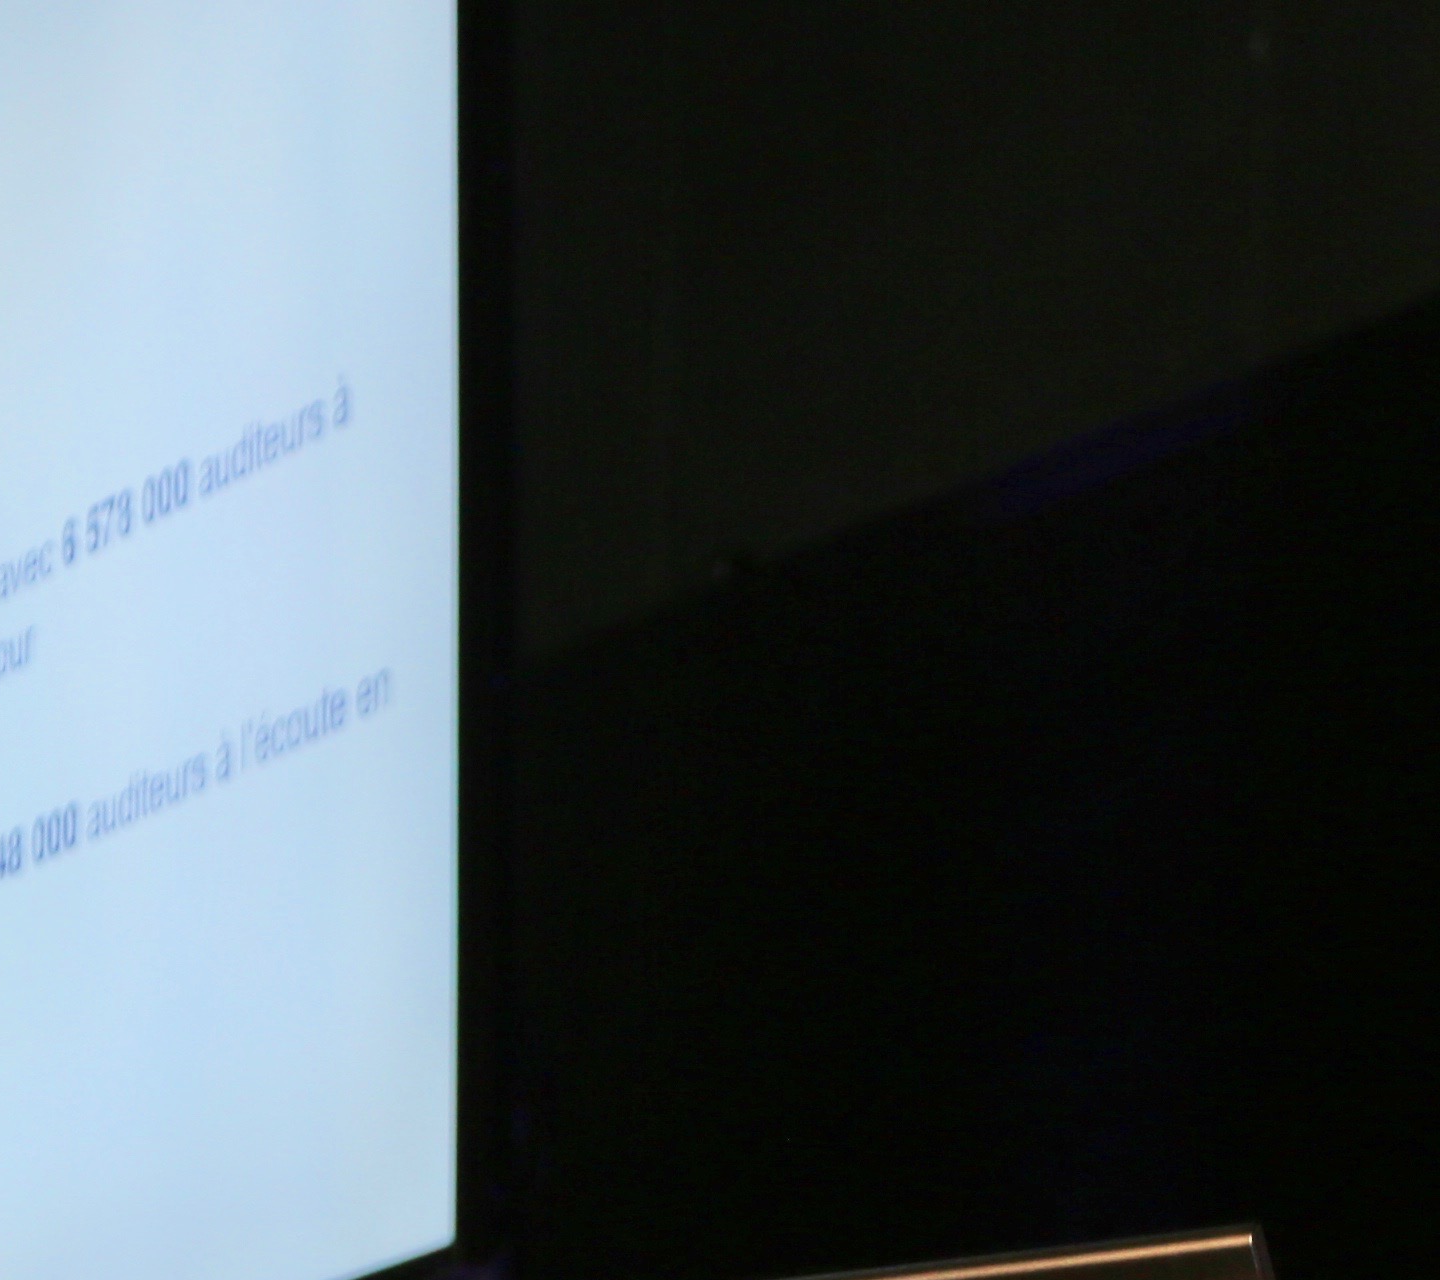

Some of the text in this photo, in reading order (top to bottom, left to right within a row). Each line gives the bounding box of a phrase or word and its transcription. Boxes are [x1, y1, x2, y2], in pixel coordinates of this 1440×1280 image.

[62, 517, 77, 565] 6
[141, 458, 190, 525] 000
[198, 398, 324, 497] auditeurs
[332, 372, 352, 427] à
[30, 800, 77, 865] 000
[86, 752, 207, 840] auditeurs
[215, 726, 232, 782] à
[240, 685, 347, 770] l'écoute
[356, 667, 392, 720] en
